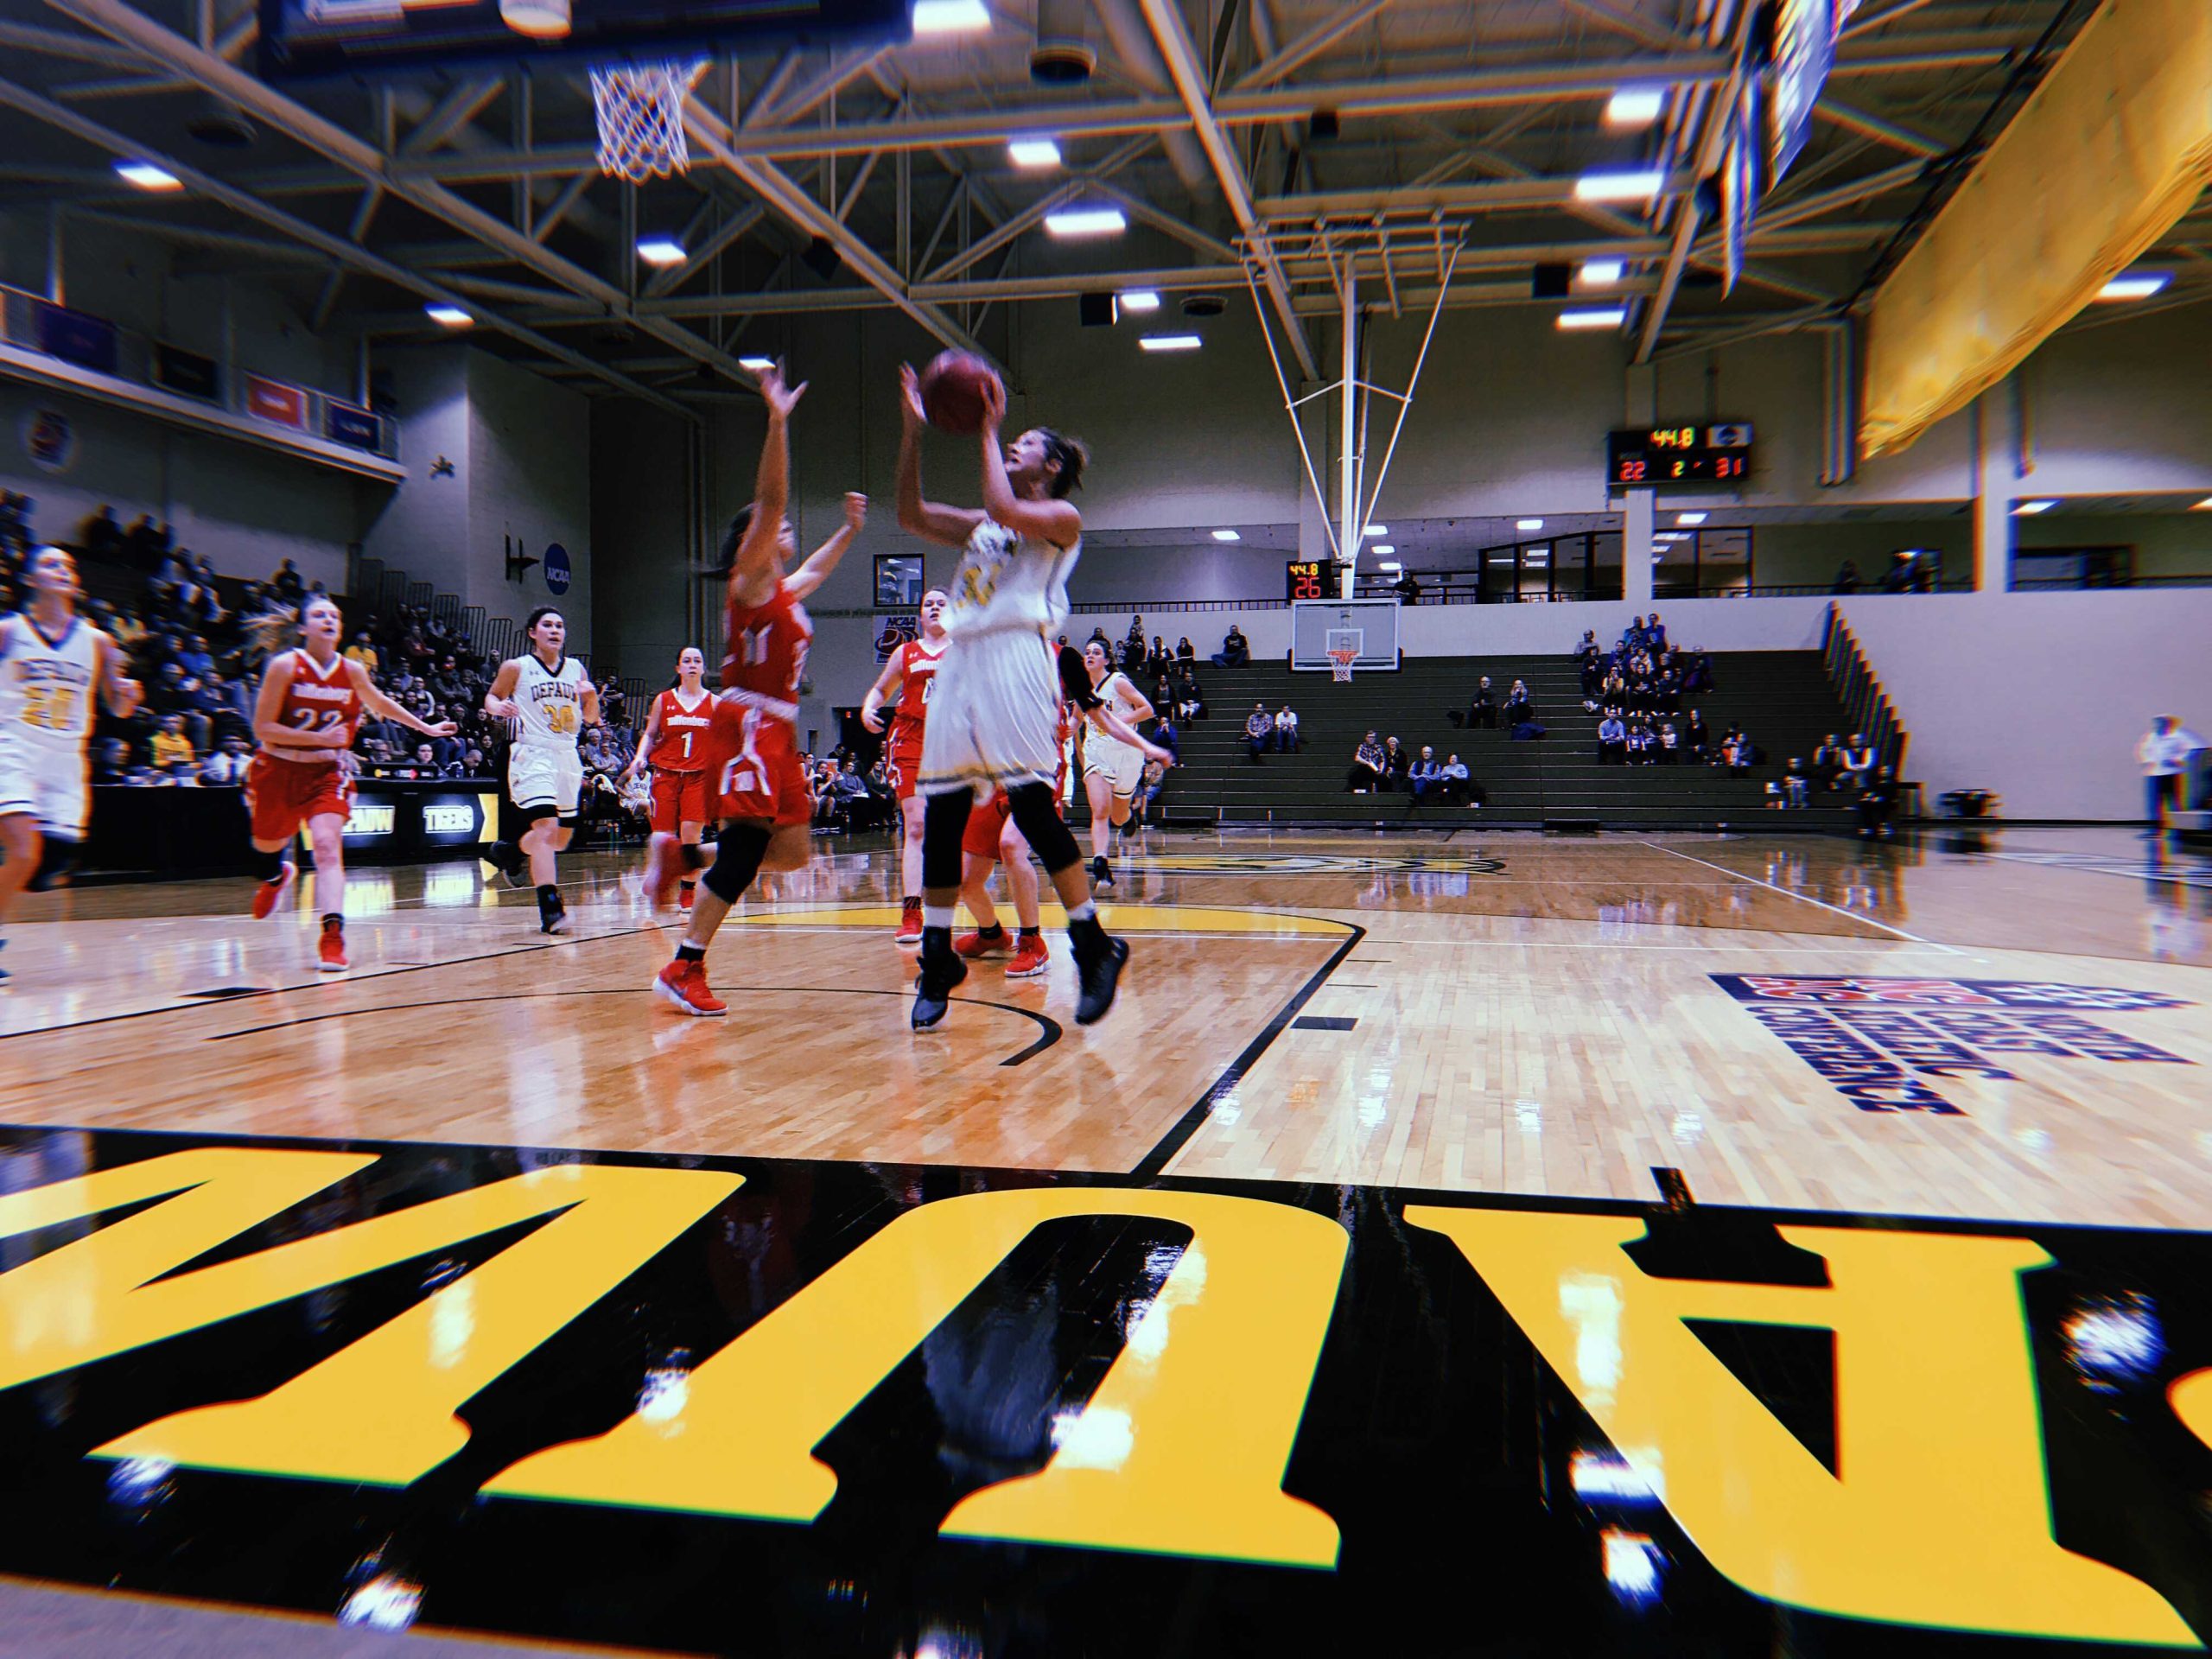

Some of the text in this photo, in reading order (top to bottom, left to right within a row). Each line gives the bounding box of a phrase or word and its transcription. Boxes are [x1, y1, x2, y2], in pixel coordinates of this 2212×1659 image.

[1620, 457, 1743, 481] 22 2 31
[546, 567, 570, 584] NCAA
[1289, 563, 1319, 575] 44.8
[1294, 576, 1321, 599] 26
[681, 731, 694, 759] 1
[1823, 1007, 2025, 1082] ATHLETIC
[1745, 1005, 1971, 1117] CONFERENCE
